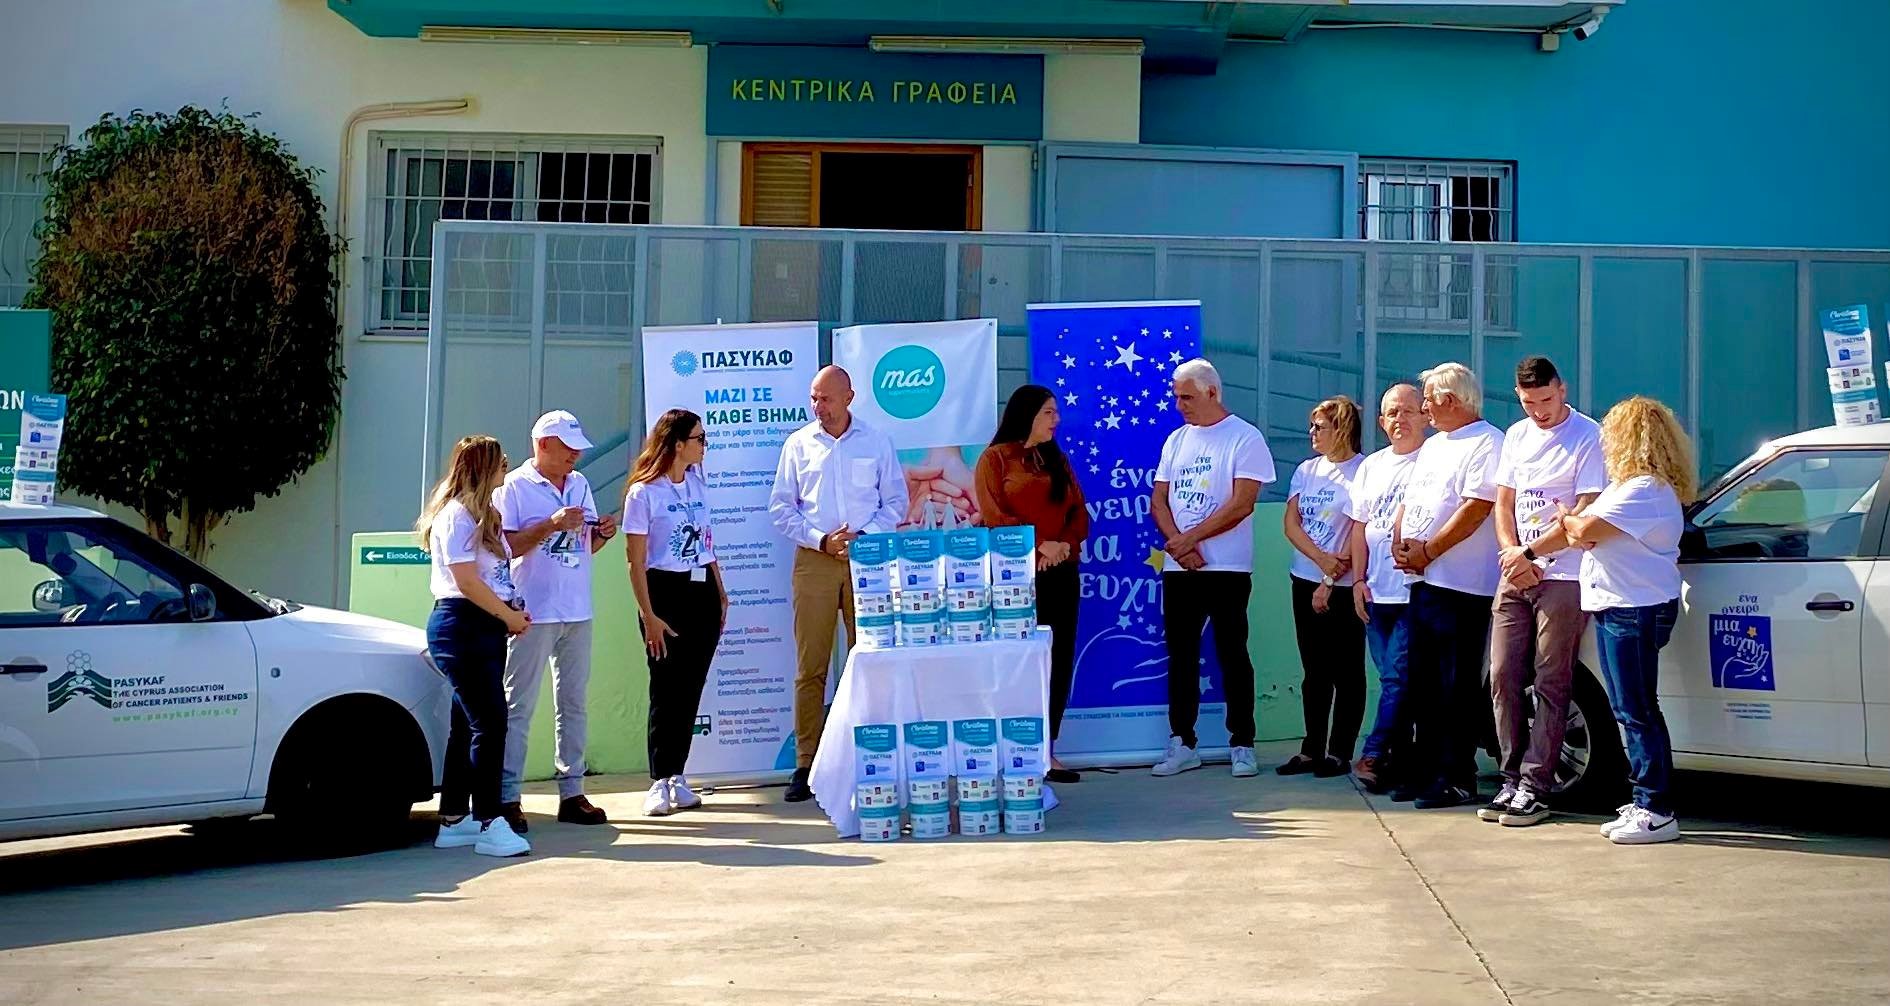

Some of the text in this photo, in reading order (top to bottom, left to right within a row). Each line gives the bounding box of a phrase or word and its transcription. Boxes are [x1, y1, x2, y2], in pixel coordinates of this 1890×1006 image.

[732, 79, 1017, 104] ΚΕΝΤΡΙΚΑ ΓΡΑΦΕΙΑ
[702, 350, 793, 368] ΠΑΣΥΚΑΦ
[881, 365, 936, 389] mas
[705, 387, 773, 404] ΜΑΖΙ ΣΕ
[706, 407, 809, 425] ΚΑΘΕ ΒΗΜΑ
[1085, 494, 1151, 524] νειρ
[1080, 535, 1122, 565] ια
[1714, 620, 1740, 635] μια
[114, 676, 165, 687] PASYKAF
[113, 684, 225, 698] THE CYPRUS ASSOCIATION
[113, 701, 123, 709] OF
[126, 699, 160, 708] CANCER
[162, 696, 203, 705] PATIENTS
[213, 693, 249, 702] FRIENDS
[112, 708, 239, 722] www.pasykaf.org.cy
